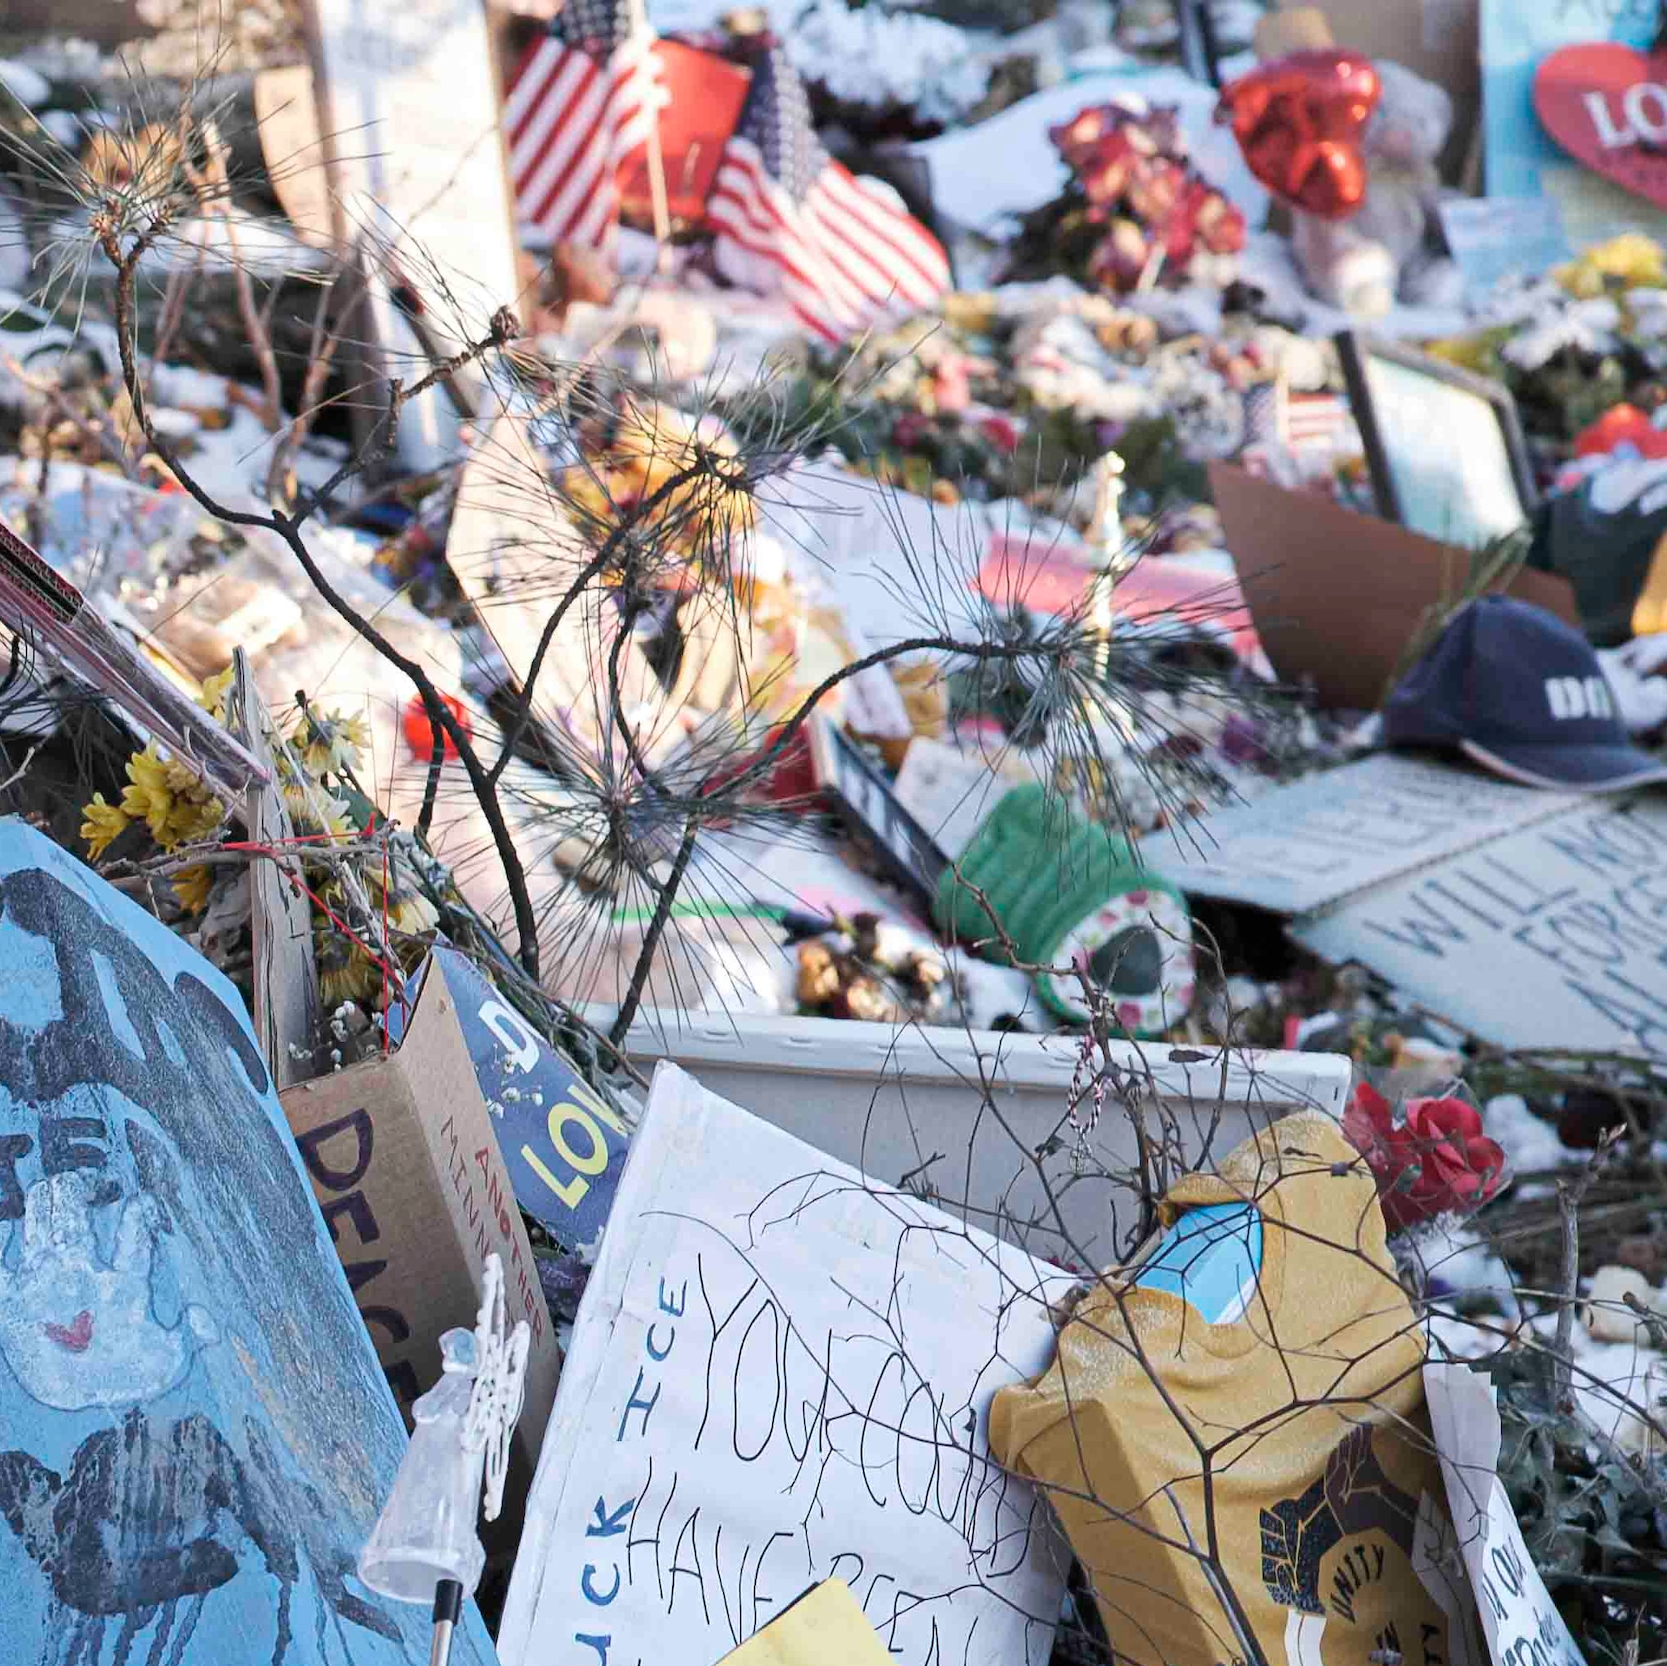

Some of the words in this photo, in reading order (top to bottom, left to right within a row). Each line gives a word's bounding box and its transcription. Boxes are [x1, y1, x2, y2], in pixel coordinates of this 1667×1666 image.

[1363, 853, 1579, 959] WILL
[473, 1145, 543, 1347] ANOTHER
[615, 1277, 688, 1444] ICE
[695, 1252, 832, 1463] YOU
[1329, 1543, 1386, 1625] UNITY
